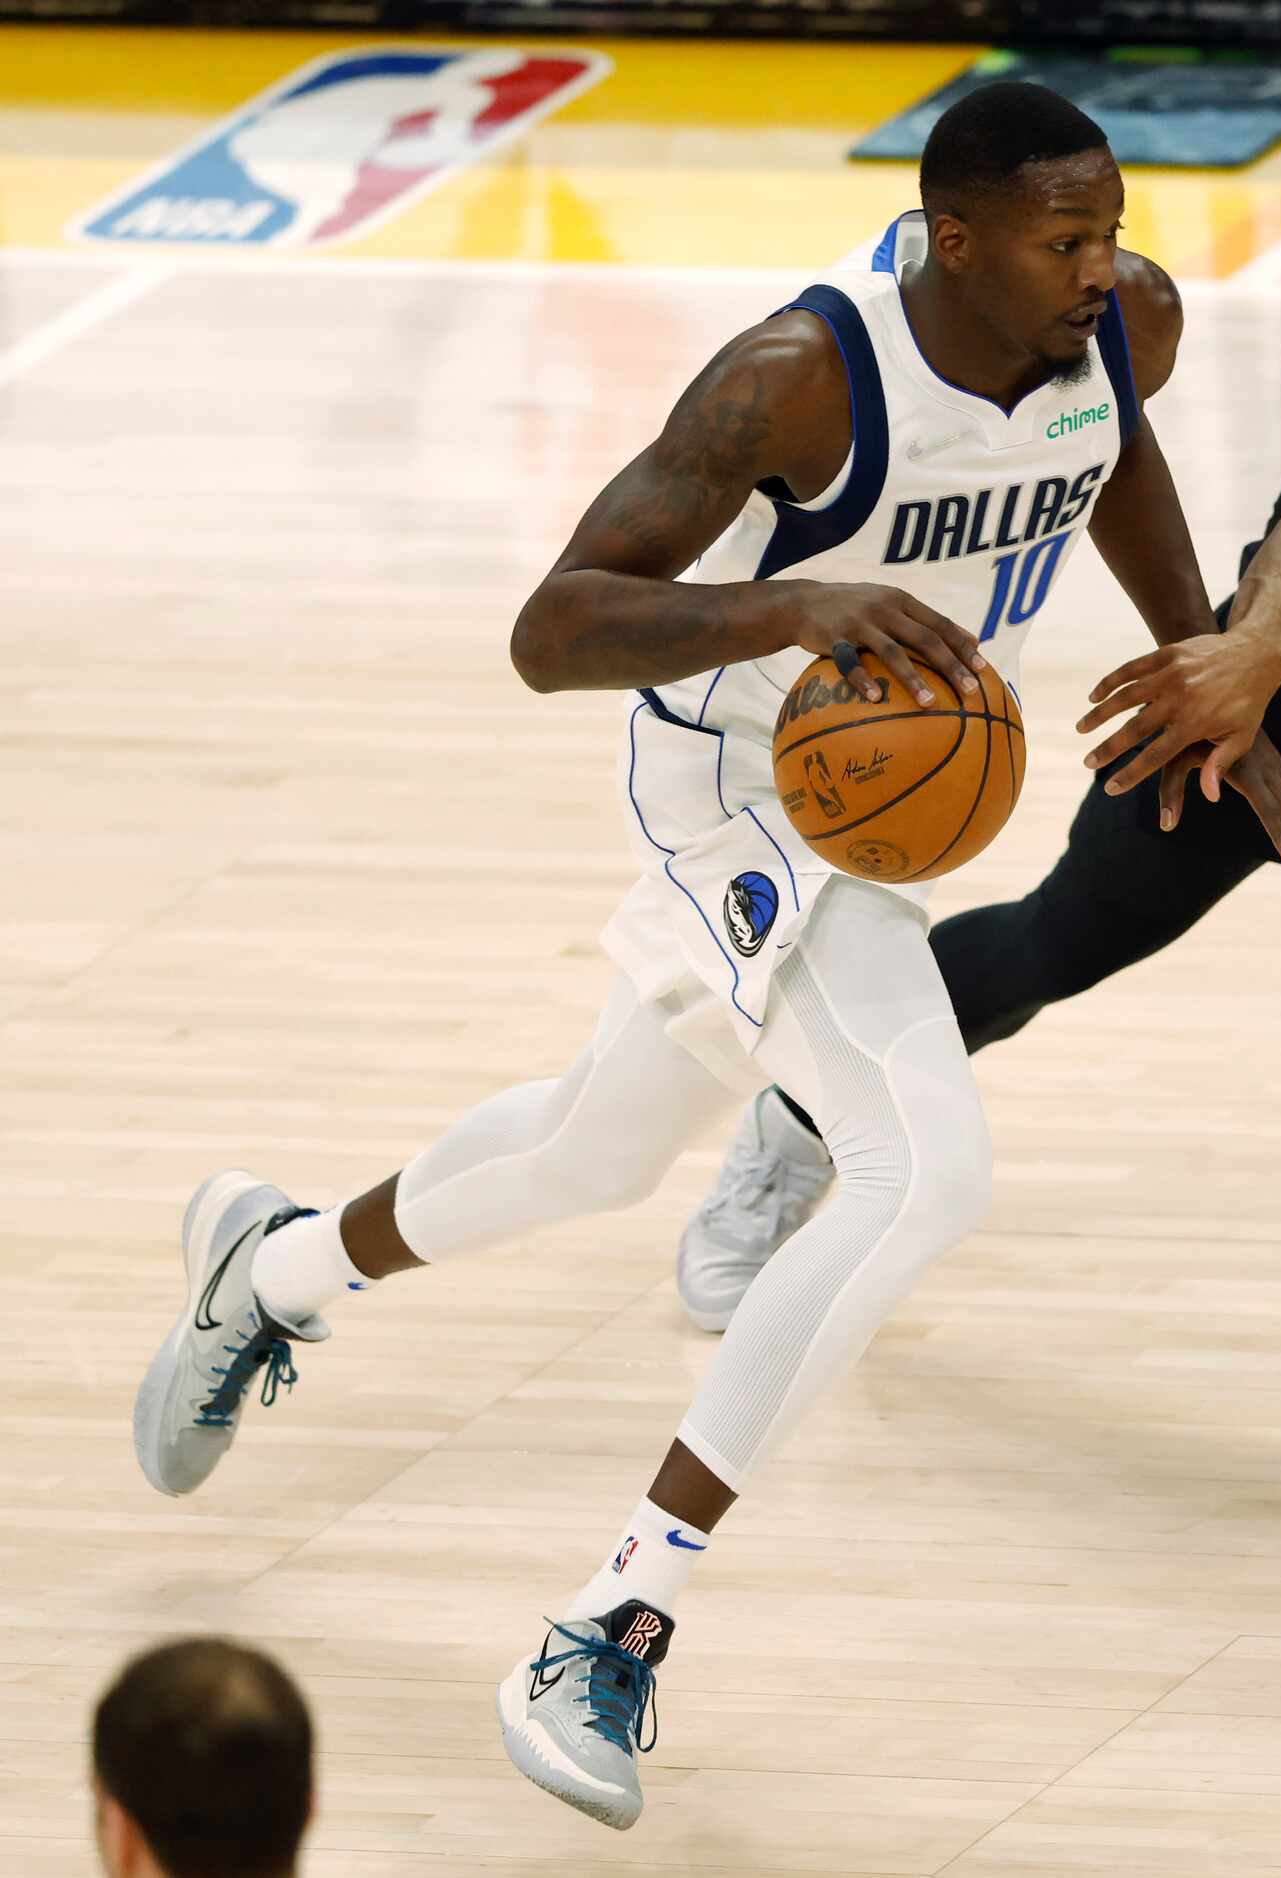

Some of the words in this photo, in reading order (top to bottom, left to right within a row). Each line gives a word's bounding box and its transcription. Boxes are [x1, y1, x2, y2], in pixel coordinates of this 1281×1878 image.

[113, 197, 273, 240] NBA
[1046, 403, 1110, 439] chime
[880, 461, 1107, 565] DALLAS
[979, 528, 1076, 643] 10
